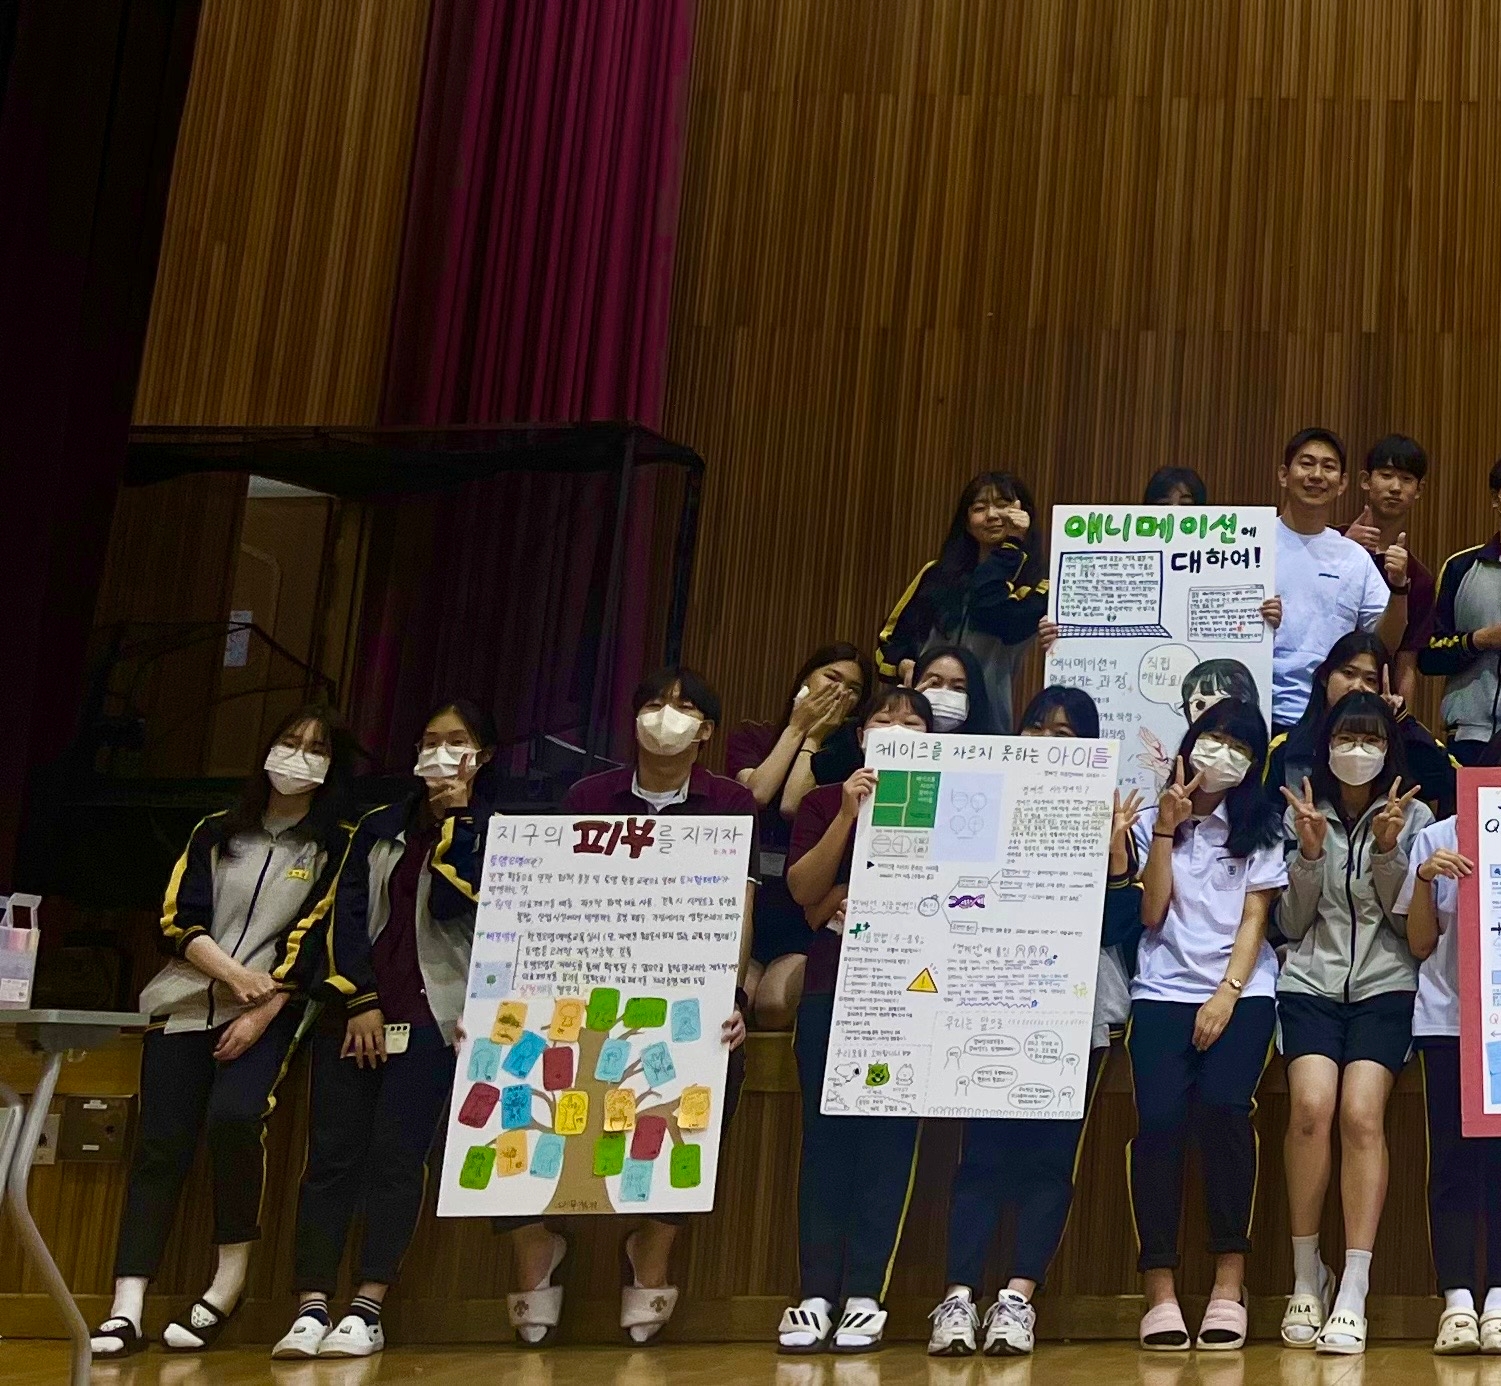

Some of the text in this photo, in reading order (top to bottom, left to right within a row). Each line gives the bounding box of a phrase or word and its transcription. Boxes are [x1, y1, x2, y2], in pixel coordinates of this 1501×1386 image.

[1171, 547, 1261, 574] 대하여!
[876, 741, 1112, 769] 케이크를 자르지 못하는 아이들
[498, 824, 563, 846] 지구의
[681, 826, 744, 845] 지키자
[1288, 1304, 1312, 1315] FILA
[1330, 1317, 1357, 1328] FILA
